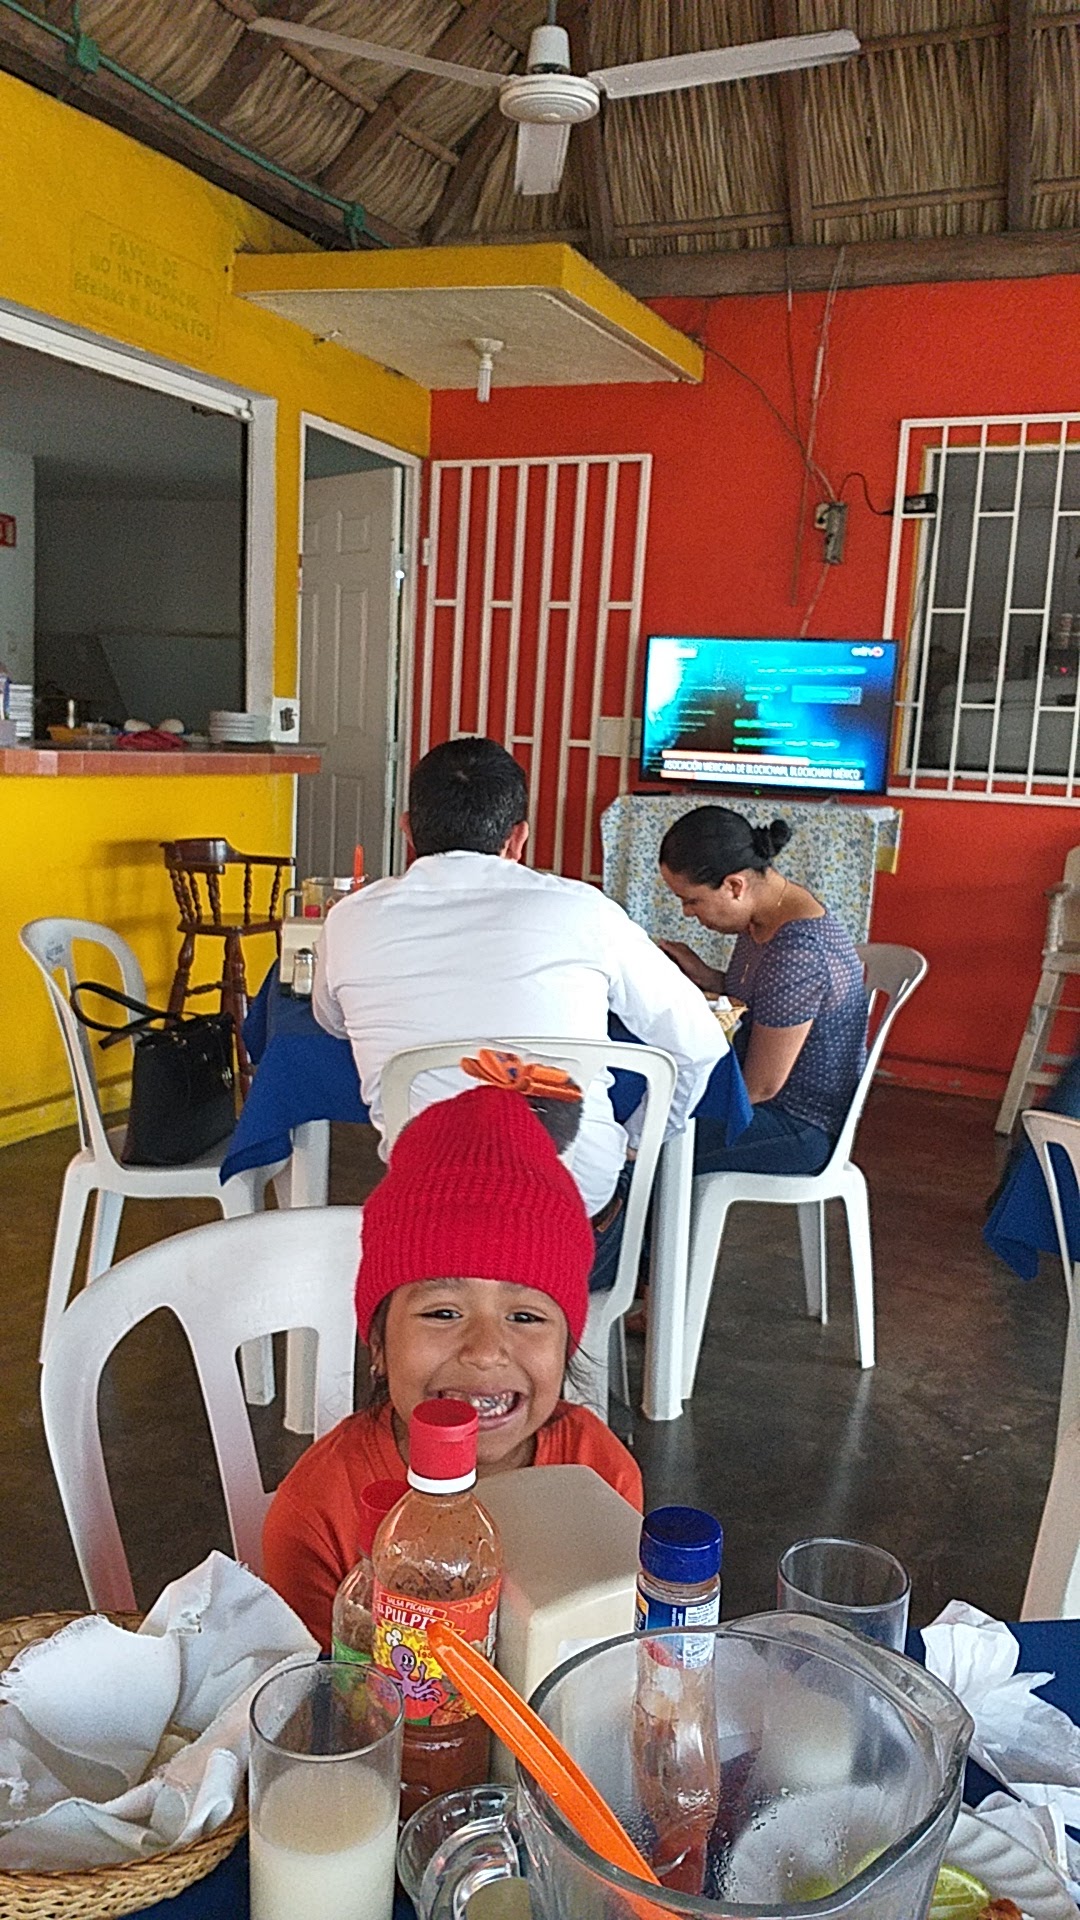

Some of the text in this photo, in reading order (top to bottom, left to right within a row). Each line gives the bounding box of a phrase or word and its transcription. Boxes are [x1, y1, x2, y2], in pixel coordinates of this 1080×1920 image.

[89, 250, 112, 275] NO
[736, 763, 745, 774] DE
[789, 765, 832, 778] BLOCKCHAIN
[386, 1596, 434, 1616] SALSA PICANTE
[377, 1604, 384, 1614] EL
[385, 1605, 450, 1630] PULPI
[418, 1650, 433, 1659] 195
